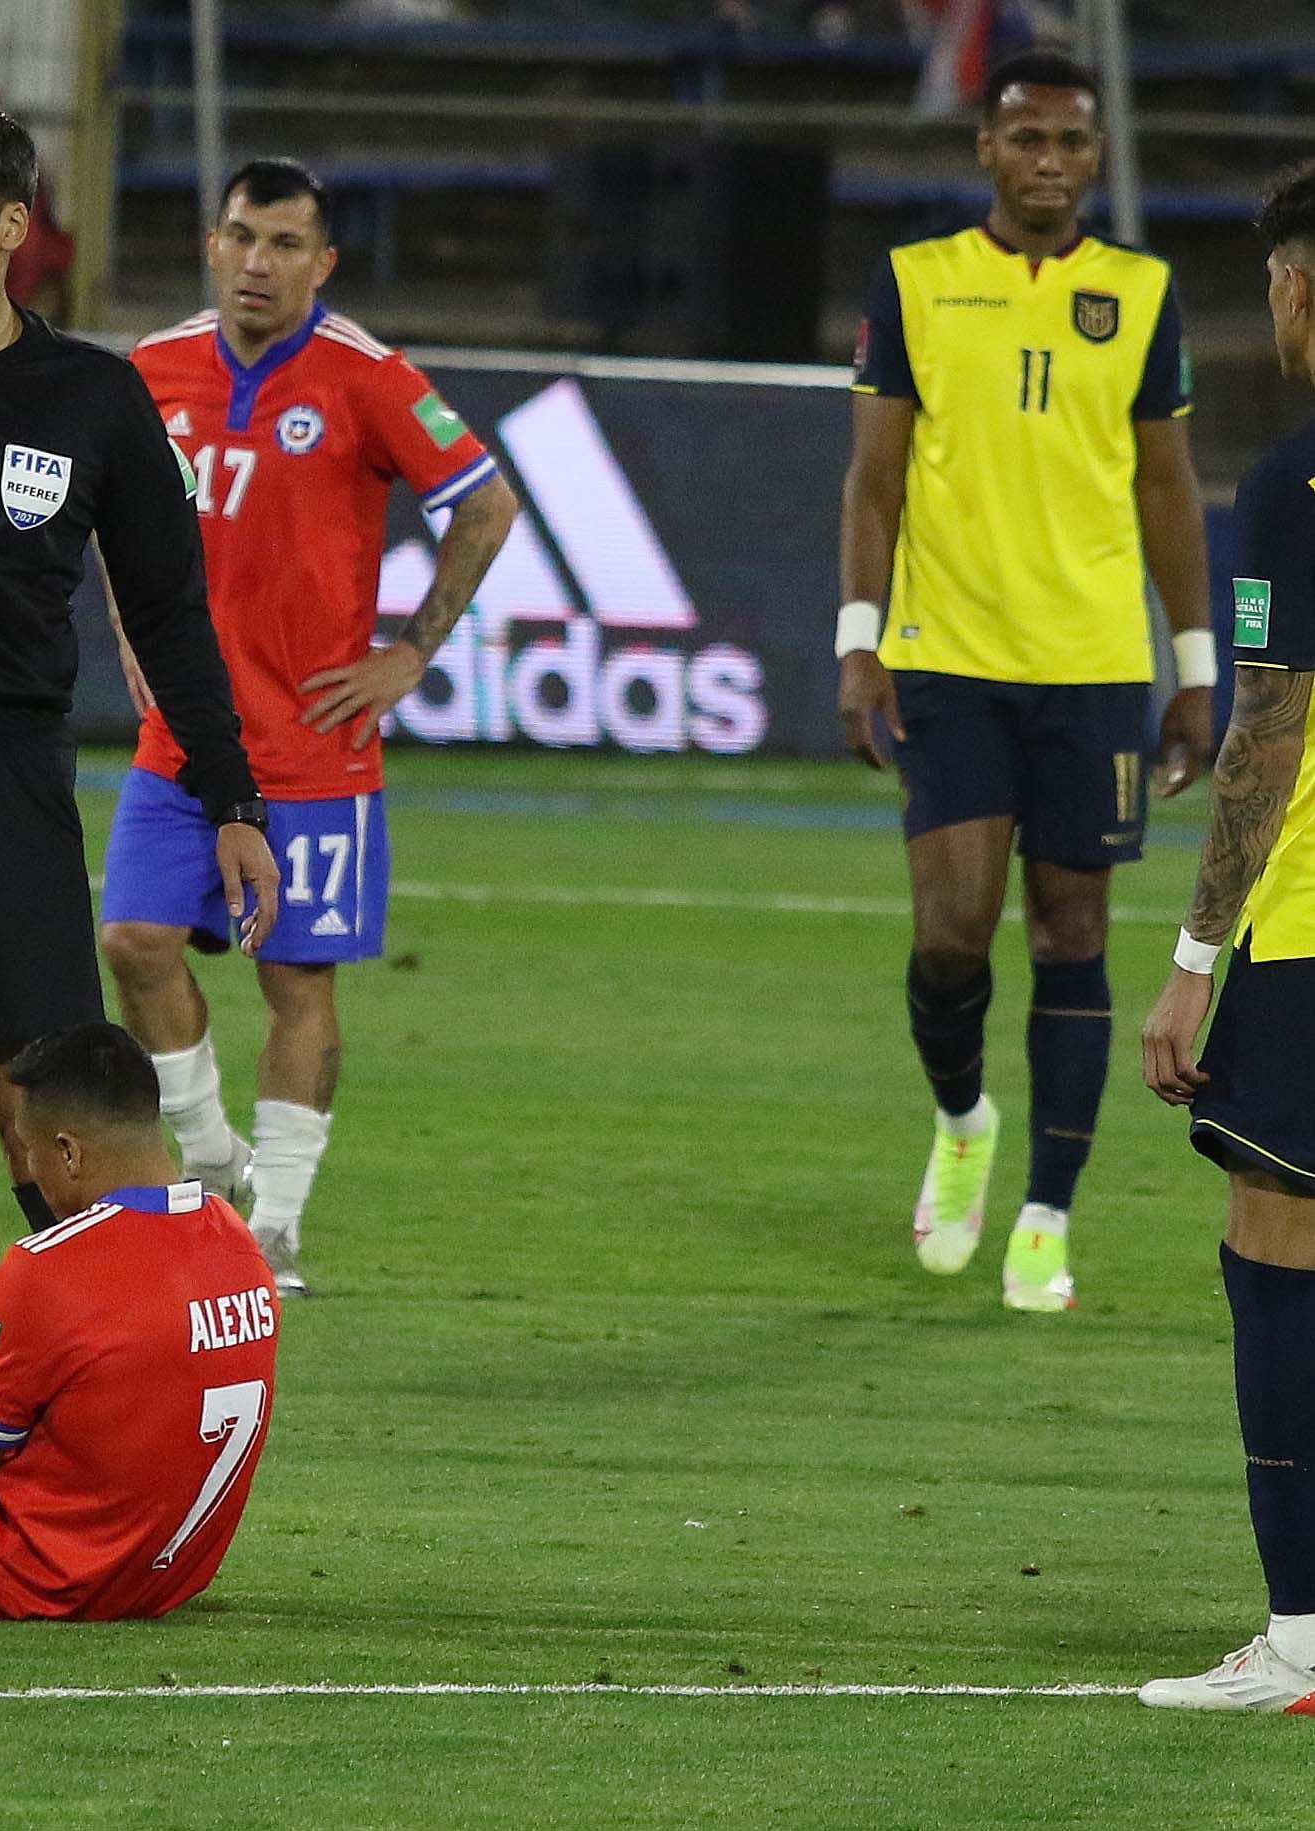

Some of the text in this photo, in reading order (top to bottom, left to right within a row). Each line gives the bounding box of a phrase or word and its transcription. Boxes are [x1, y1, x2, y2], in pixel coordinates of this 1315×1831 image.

[1021, 348, 1052, 413] 11
[7, 481, 60, 503] REFEREE
[10, 450, 63, 478] FIFA
[193, 444, 258, 520] 17
[14, 511, 39, 524] 2021
[371, 614, 769, 755] didas
[1113, 752, 1140, 823] 11
[286, 833, 351, 907] 17
[189, 1286, 276, 1352] ALEXIS
[152, 1379, 267, 1570] 7
